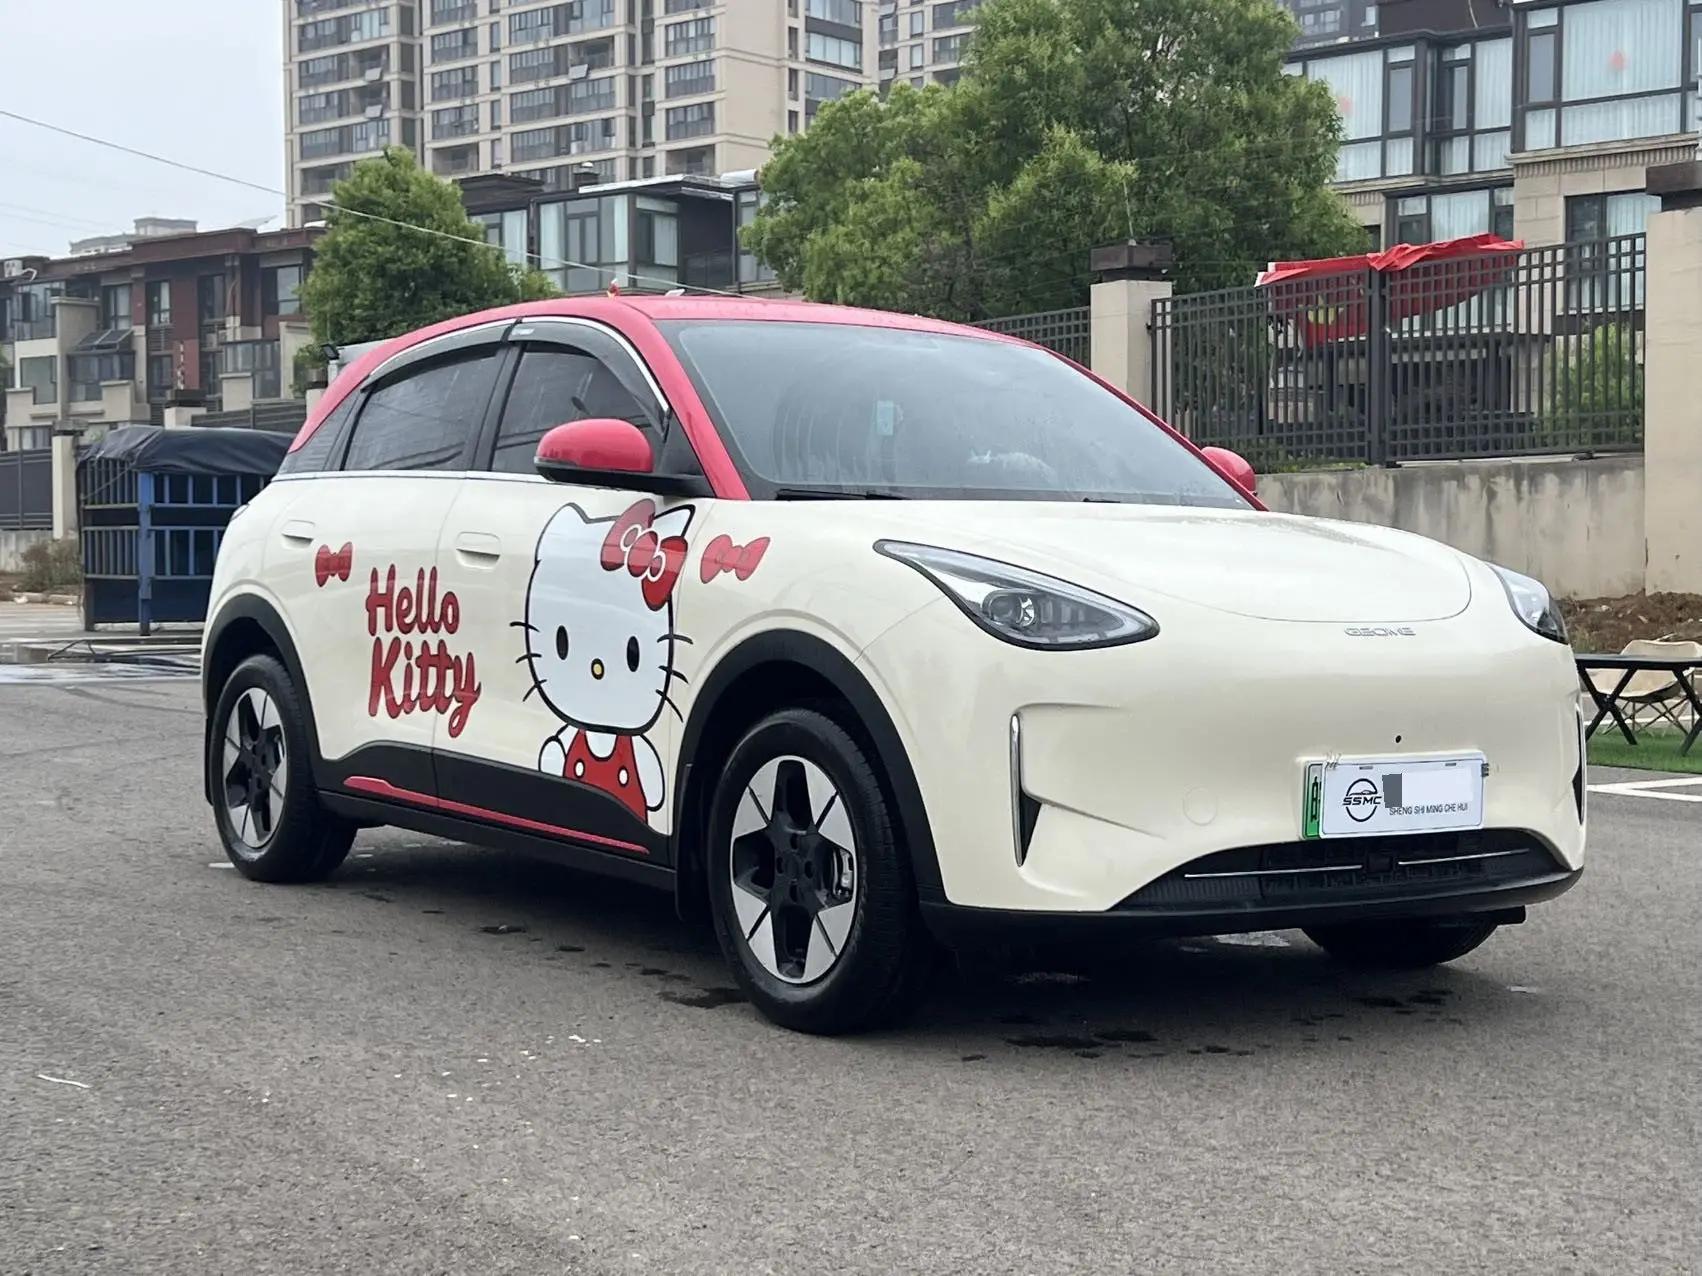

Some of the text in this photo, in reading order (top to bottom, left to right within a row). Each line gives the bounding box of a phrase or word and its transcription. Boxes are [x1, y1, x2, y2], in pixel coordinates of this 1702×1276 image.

[365, 563, 460, 637] Hello
[368, 636, 482, 738] Kitty
[1342, 796, 1382, 806] SSMC
[1389, 806, 1413, 816] SHENG
[1426, 804, 1443, 814] MING
